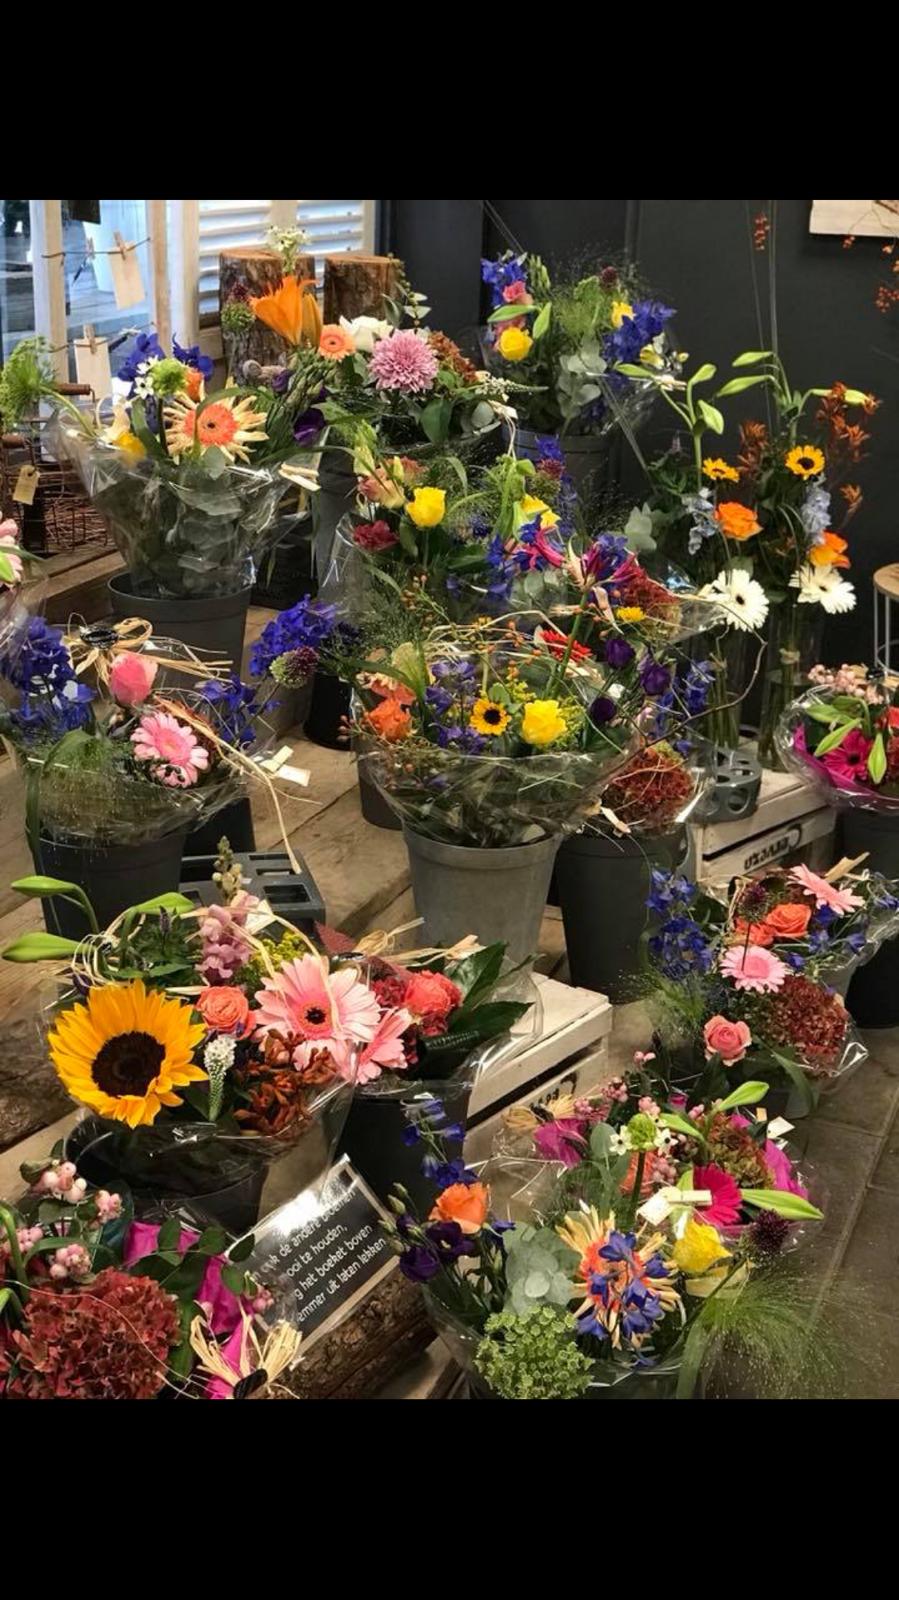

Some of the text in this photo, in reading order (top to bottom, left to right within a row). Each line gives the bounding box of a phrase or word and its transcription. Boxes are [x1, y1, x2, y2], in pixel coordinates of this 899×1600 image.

[279, 1243, 293, 1257] de
[291, 1219, 321, 1247] andere
[299, 1251, 313, 1264] te
[310, 1225, 348, 1255] houden,
[299, 1225, 373, 1291] het boeket boven
[326, 1279, 341, 1295] uit
[336, 1261, 361, 1284] laten
[356, 1238, 387, 1264] lekken
